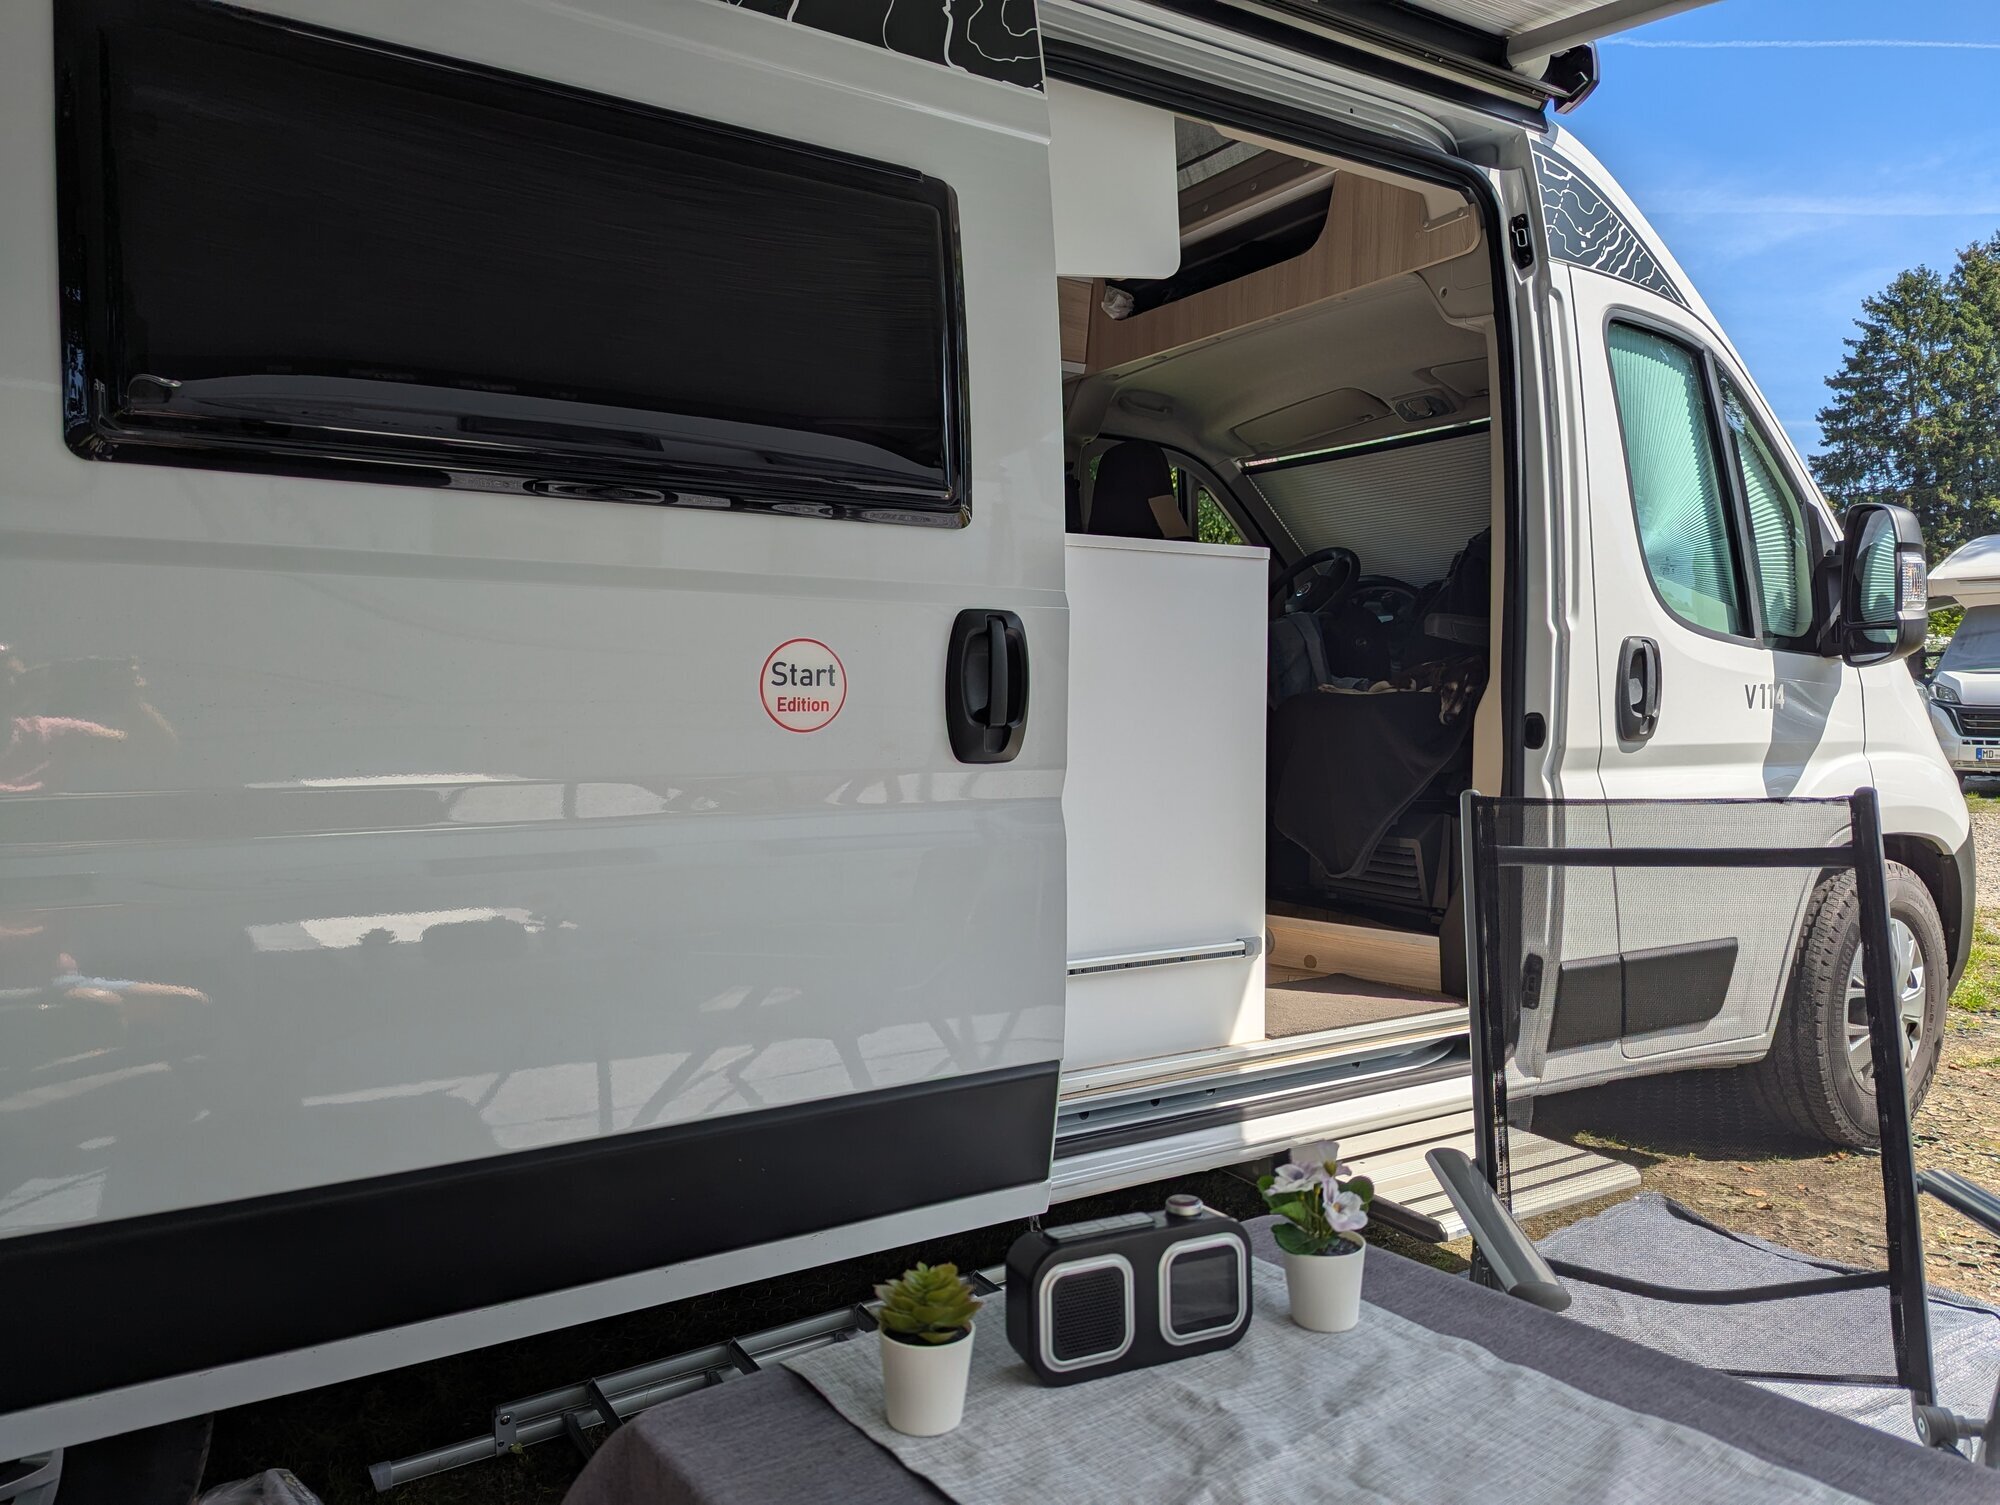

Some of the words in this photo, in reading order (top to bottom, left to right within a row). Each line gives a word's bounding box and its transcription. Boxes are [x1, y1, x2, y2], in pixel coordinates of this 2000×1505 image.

[771, 661, 836, 687] Start
[777, 697, 830, 712] Edition
[1744, 683, 1785, 709] V114
